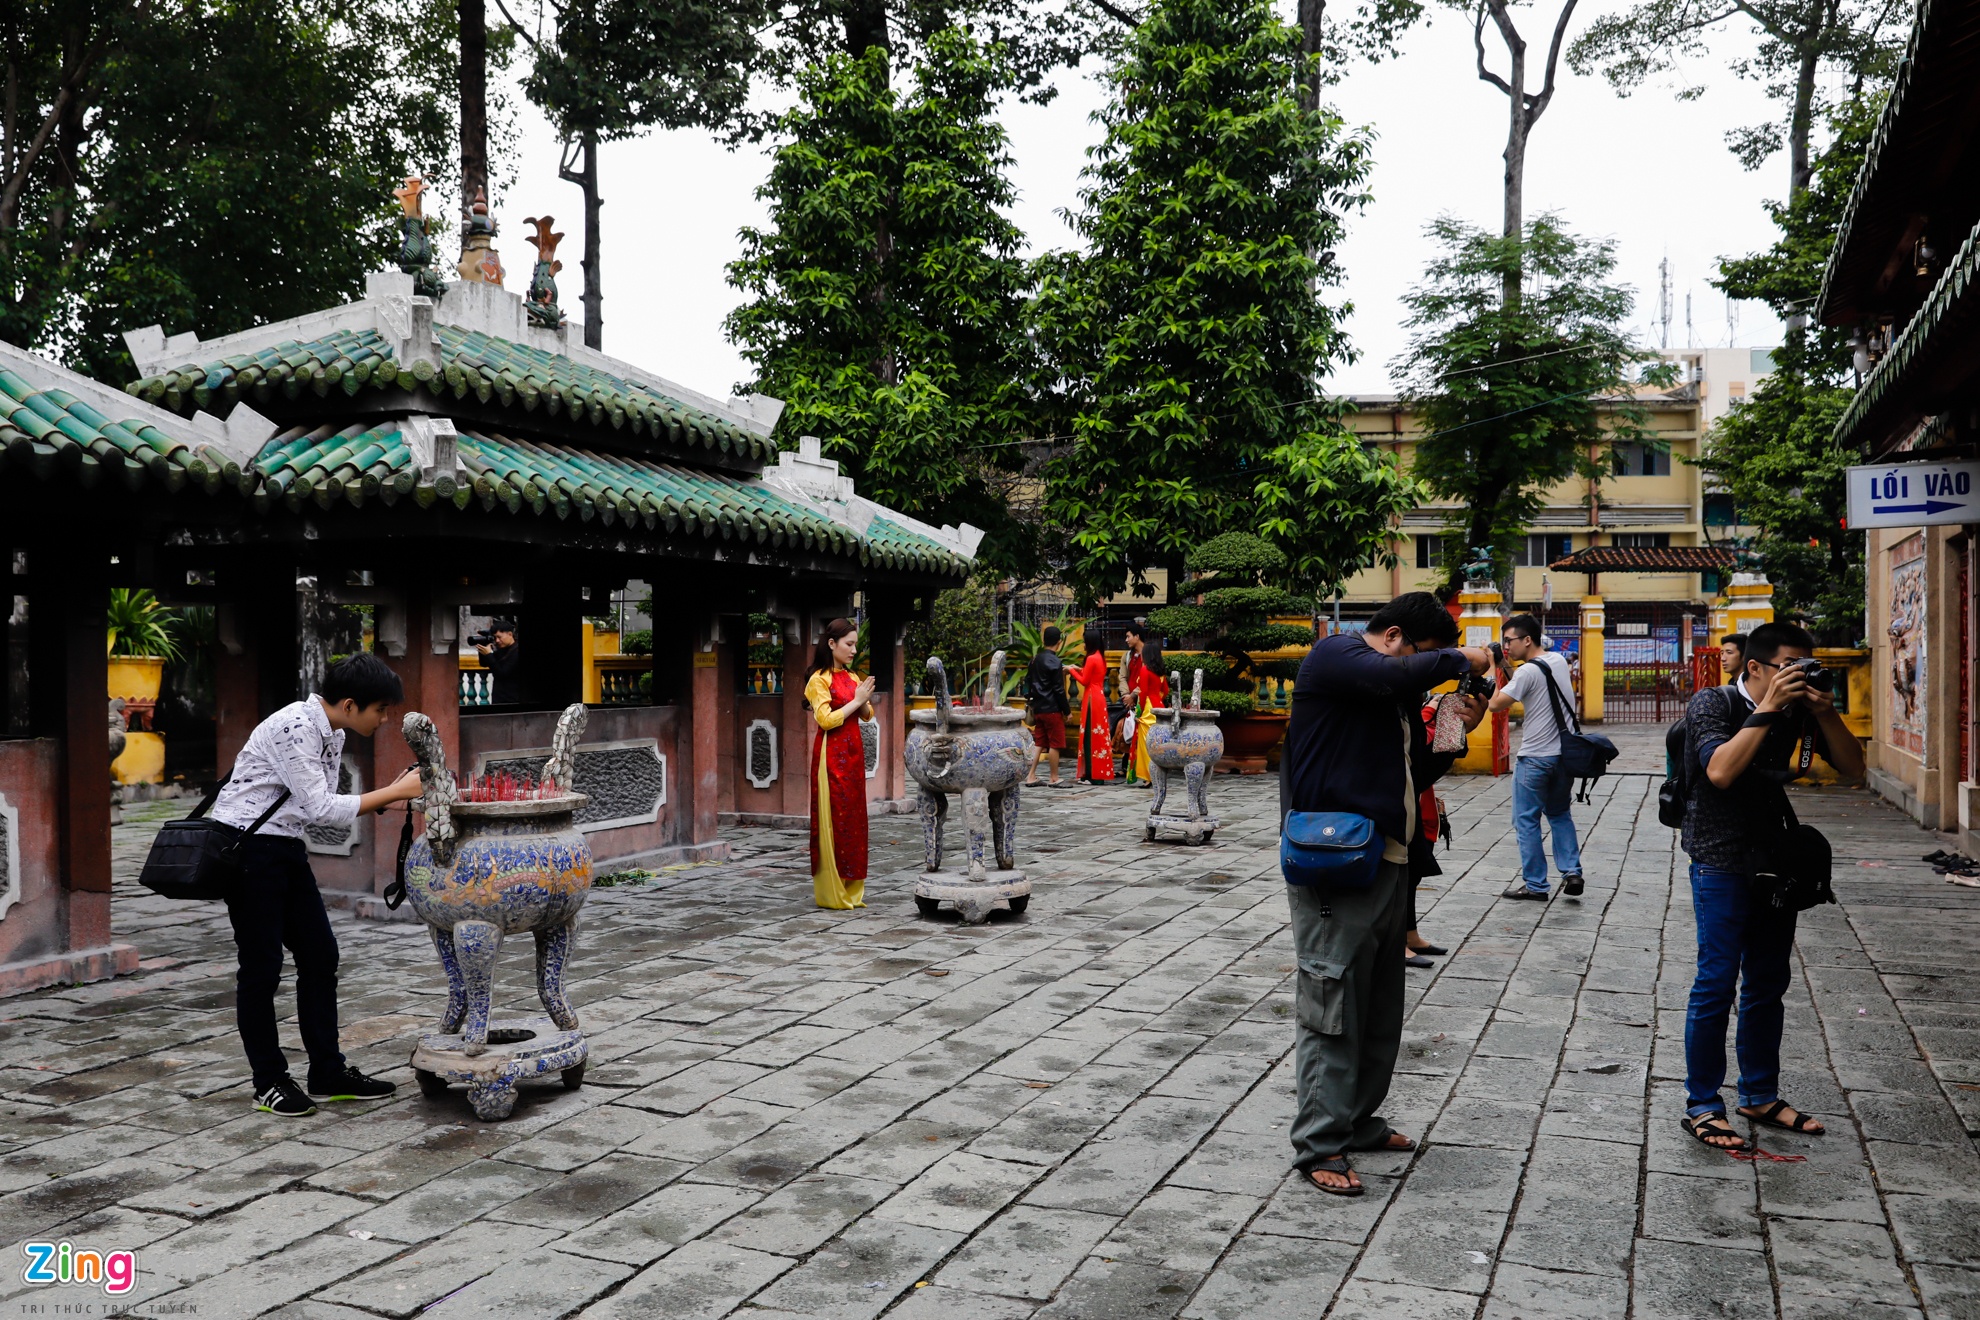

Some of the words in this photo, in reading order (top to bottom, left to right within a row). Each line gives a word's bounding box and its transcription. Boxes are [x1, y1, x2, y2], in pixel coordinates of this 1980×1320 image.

[1871, 468, 1908, 500] LỐI
[1924, 467, 1970, 497] VÀO
[1803, 735, 1813, 749] 60D
[1801, 750, 1811, 768] EOS
